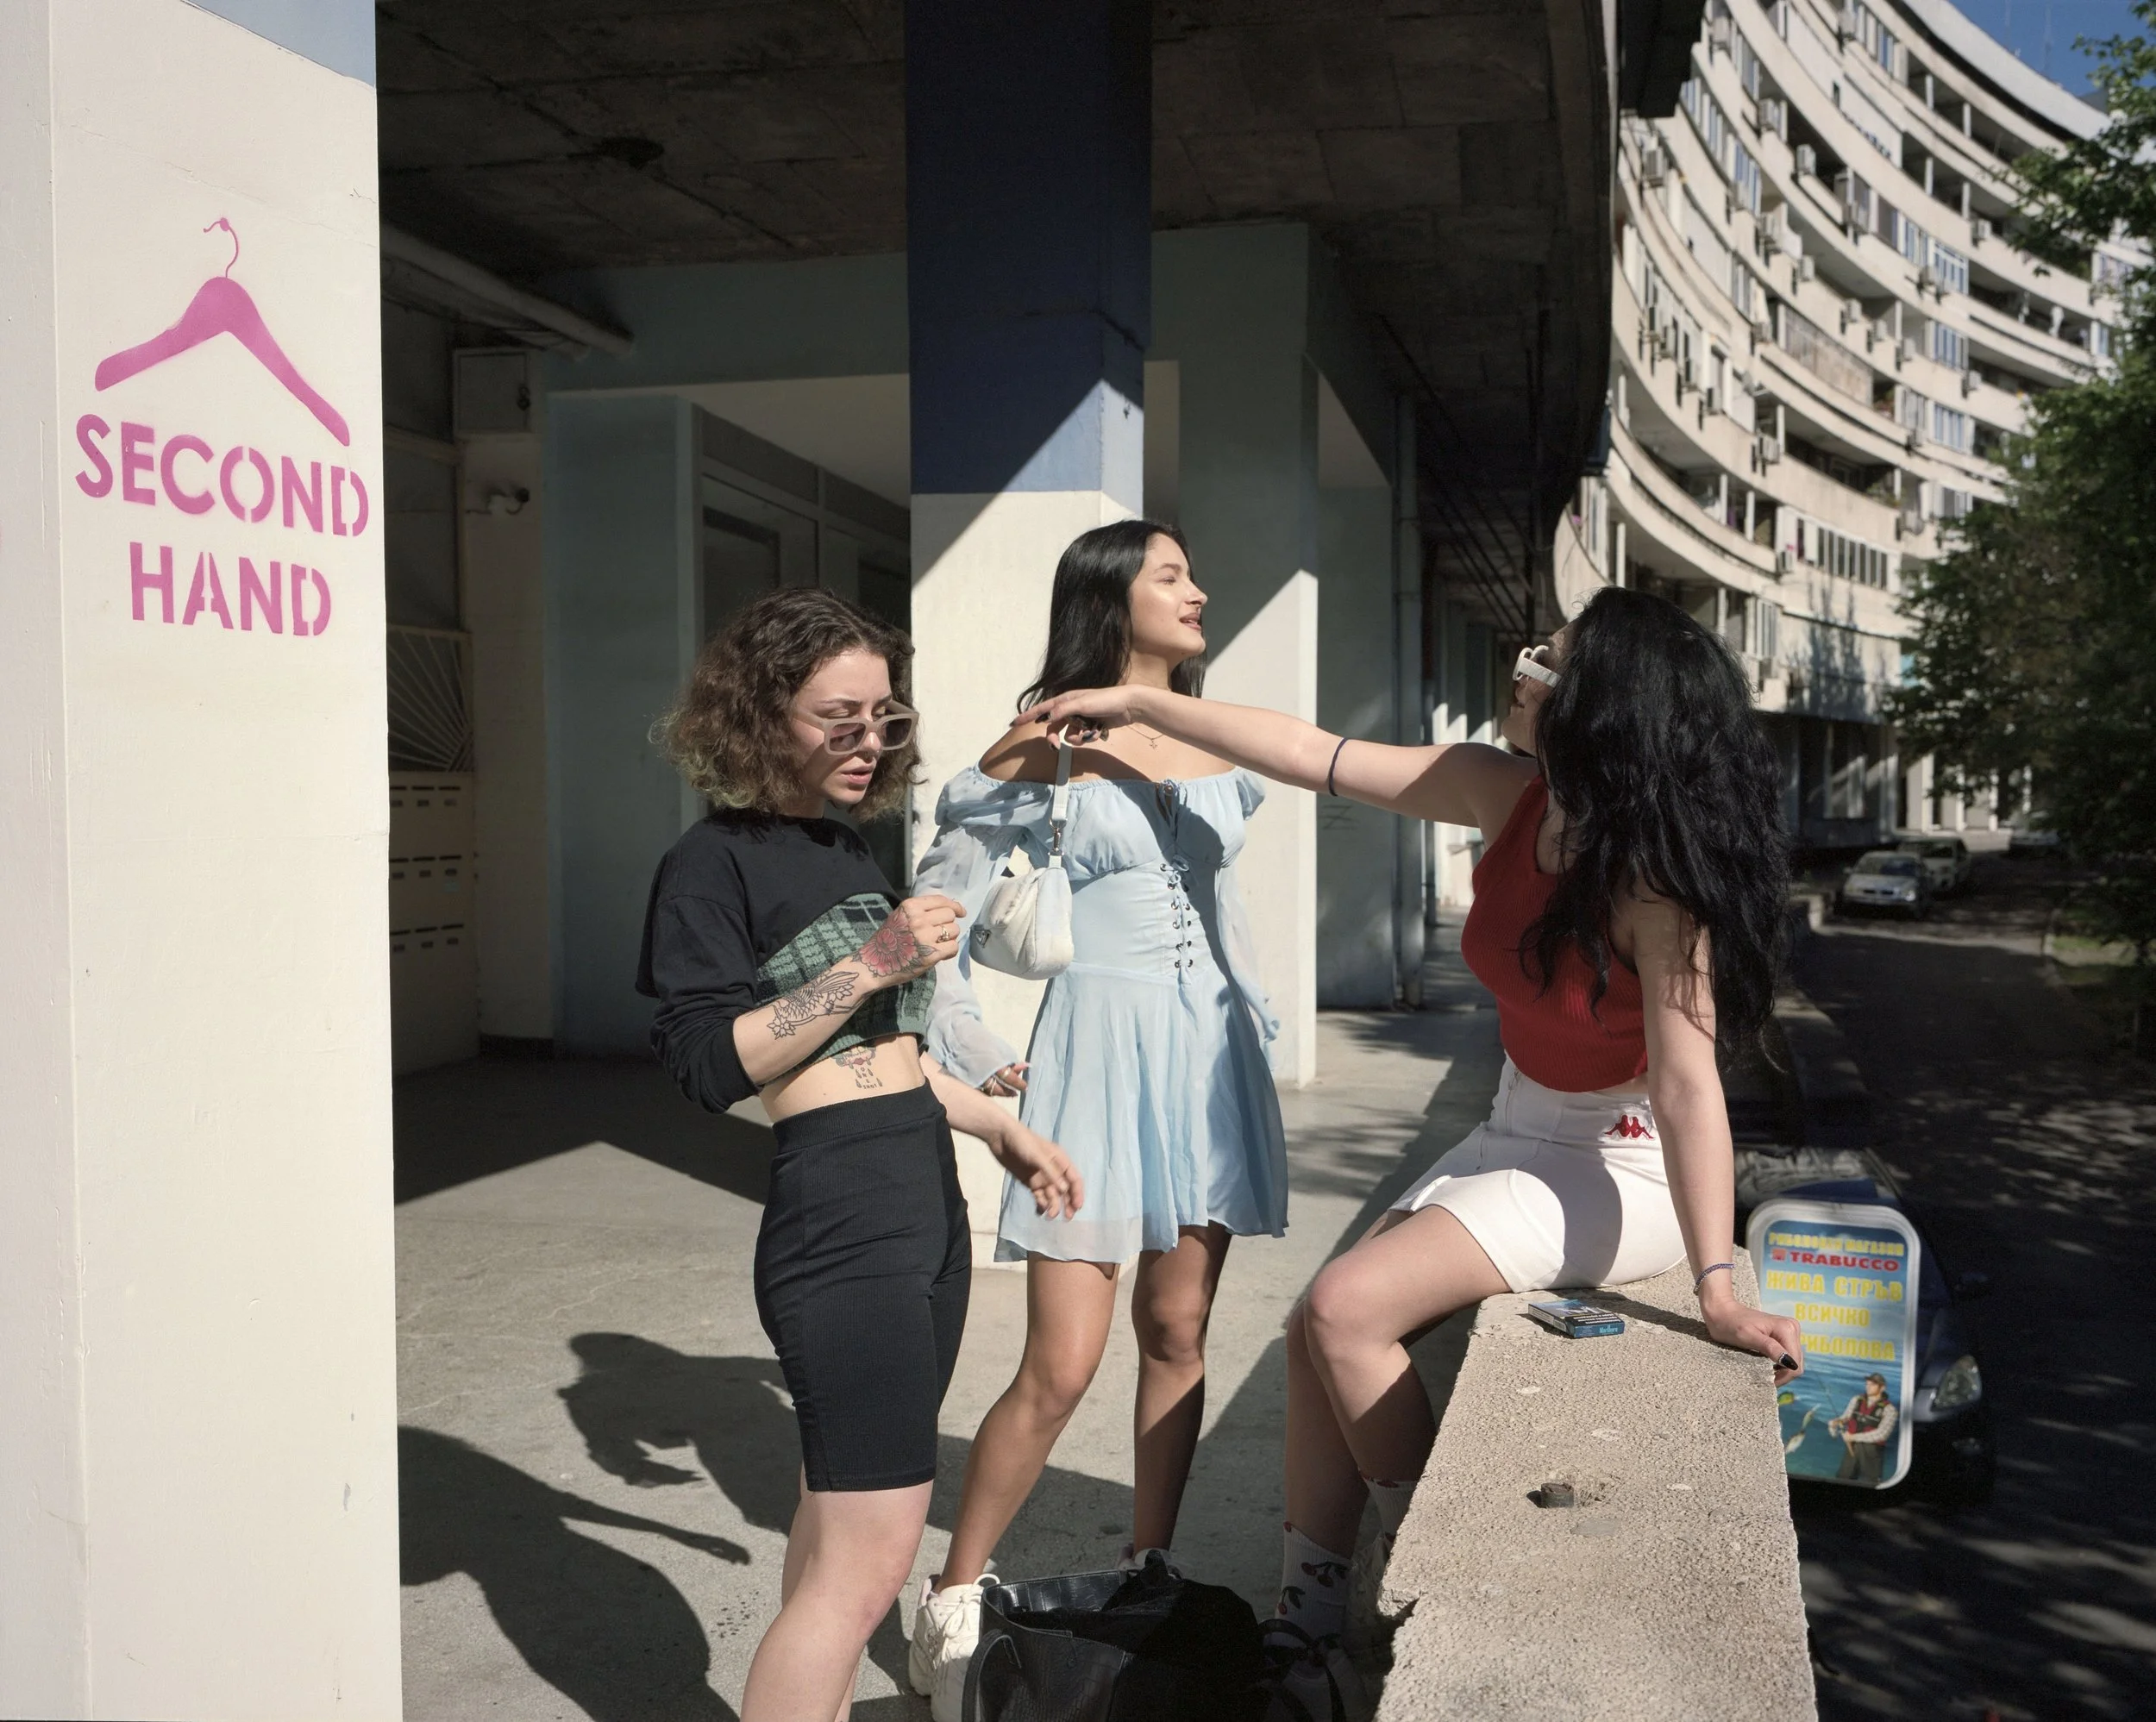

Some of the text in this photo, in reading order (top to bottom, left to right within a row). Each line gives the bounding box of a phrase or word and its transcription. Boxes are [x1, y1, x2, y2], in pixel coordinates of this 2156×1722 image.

[75, 414, 369, 536] SECOND
[129, 542, 331, 636] HAND
[1790, 1251, 1899, 1271] TRABUCCO
[1766, 1270, 1902, 1300] ЖИВА СТРЪВ
[1795, 1303, 1870, 1327] ВСИЧКО
